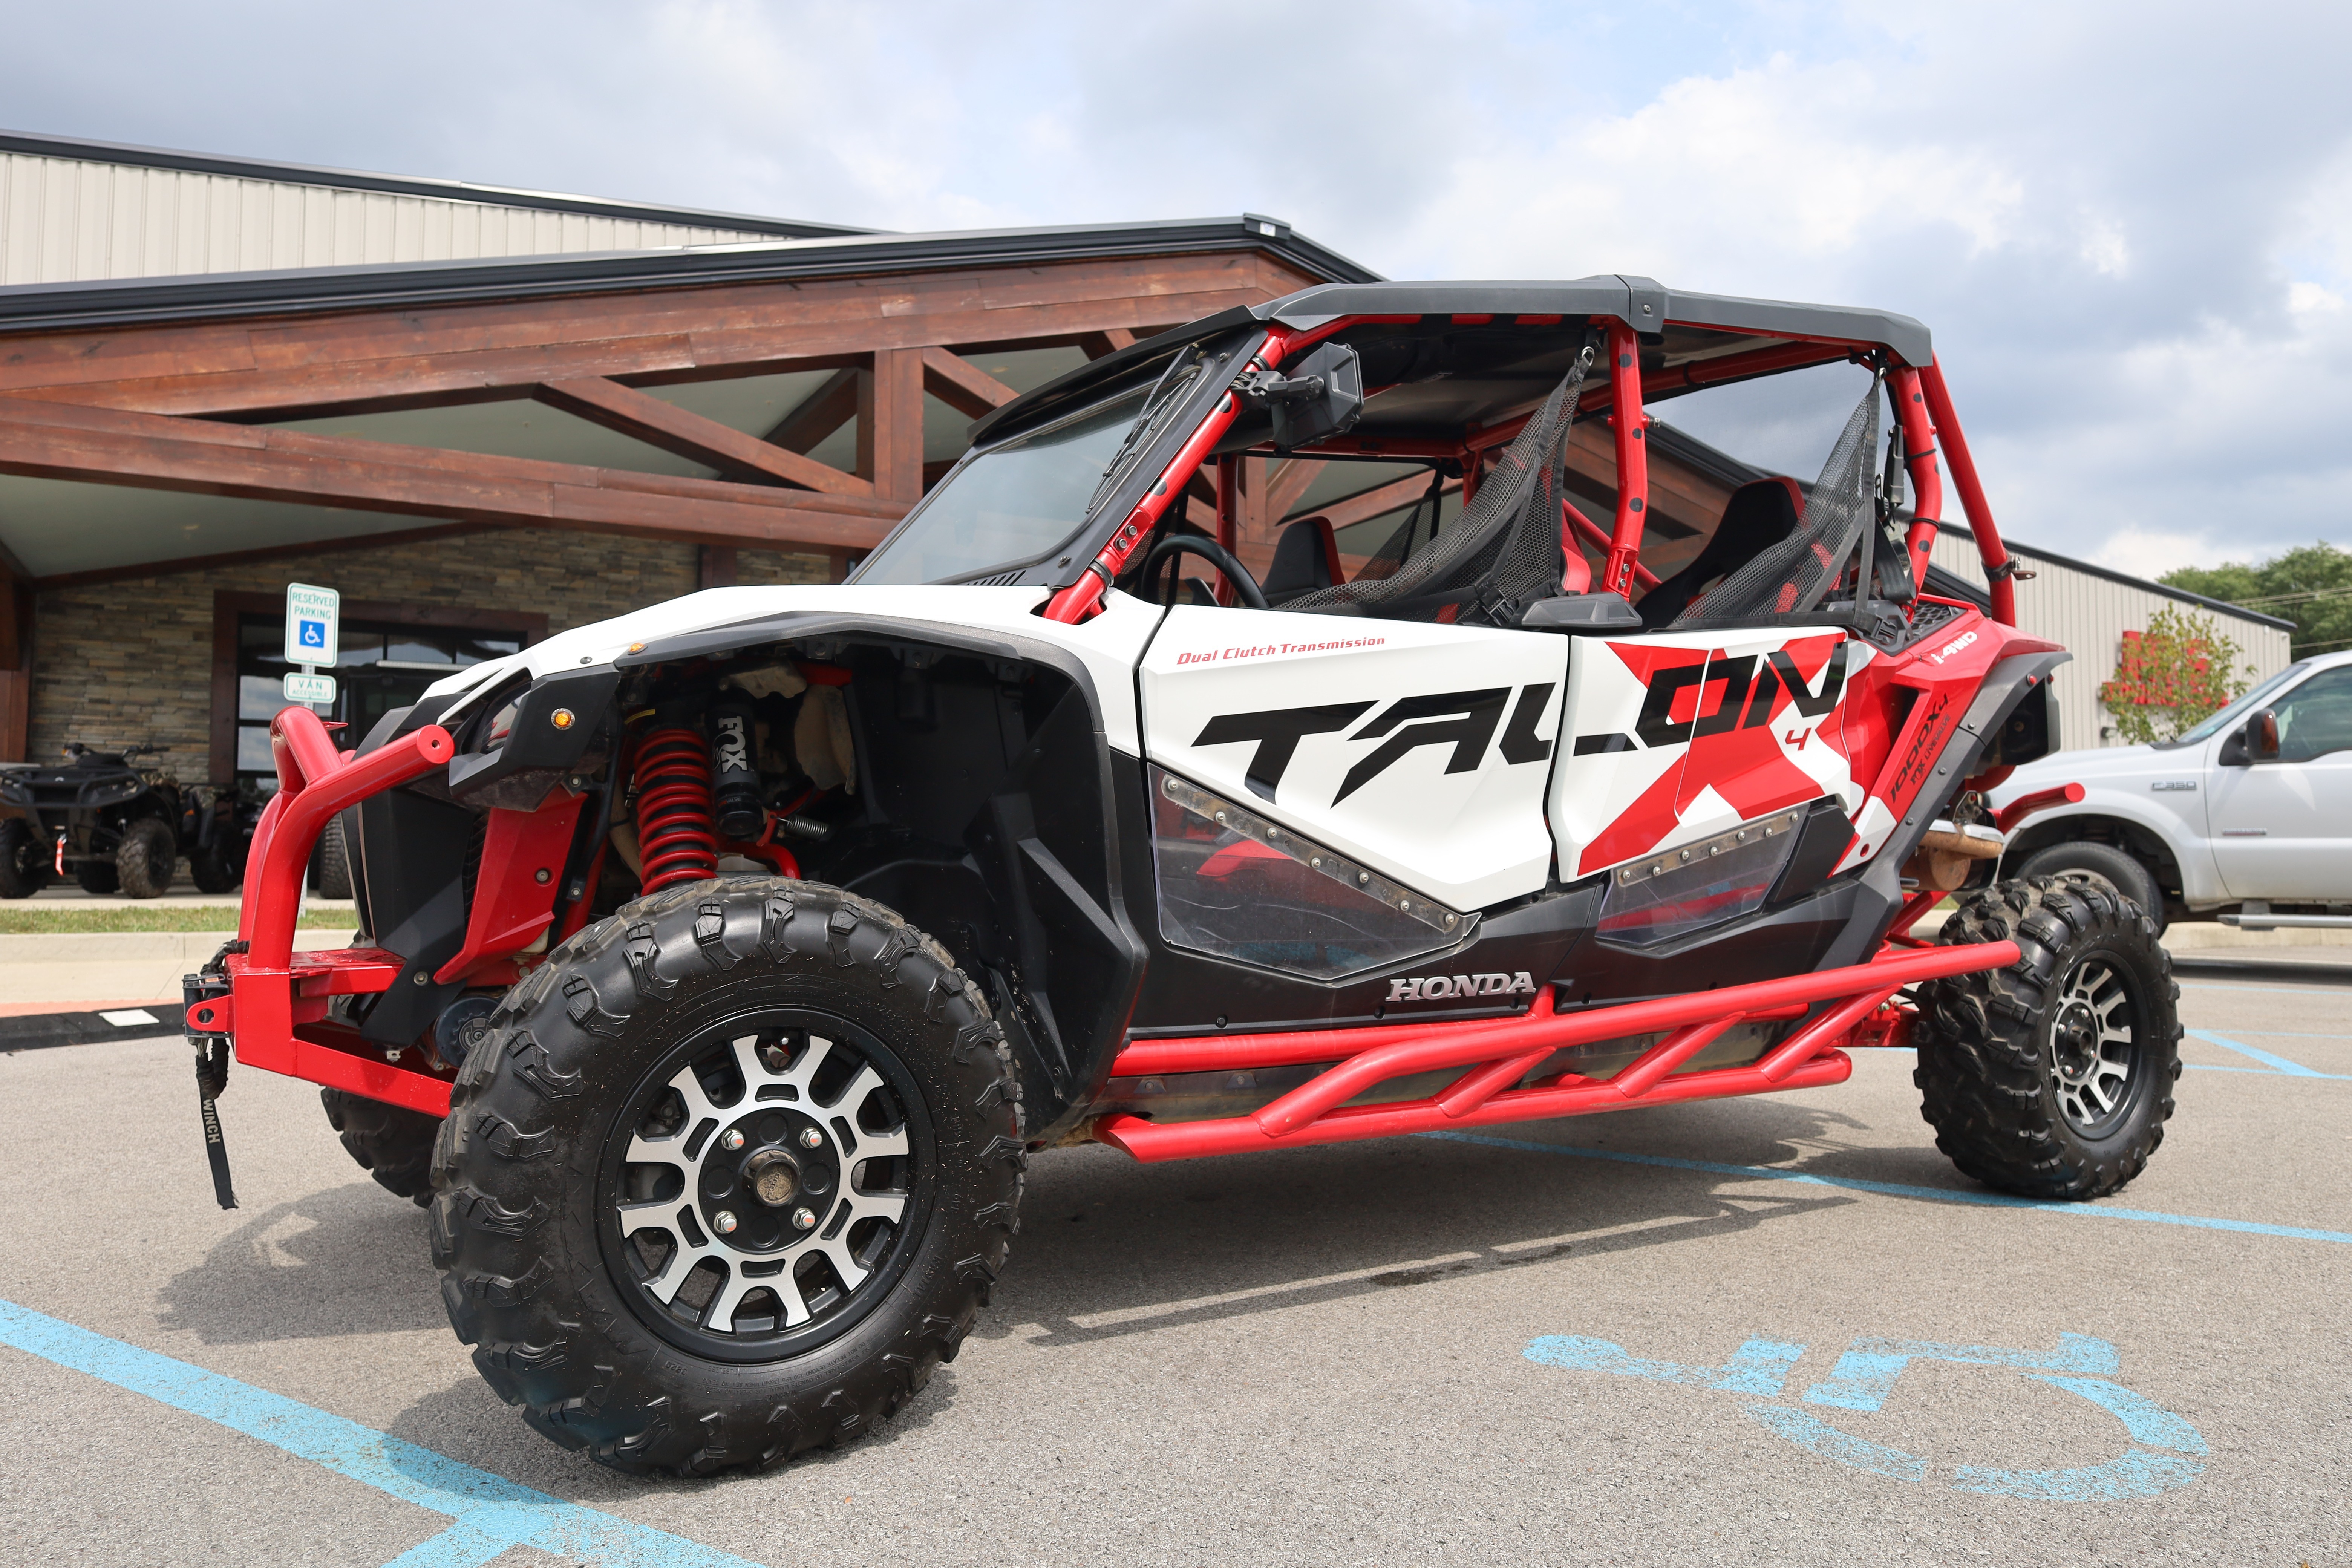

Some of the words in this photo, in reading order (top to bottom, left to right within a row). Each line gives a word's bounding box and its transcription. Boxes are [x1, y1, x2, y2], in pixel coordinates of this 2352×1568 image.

[292, 592, 334, 606] RESERVED
[294, 606, 331, 620] PARKING
[1177, 639, 1219, 665] Dual
[1222, 645, 1276, 660] Clutch
[1280, 637, 1385, 654] Transmission
[1930, 631, 1978, 665] i-4WD
[292, 689, 328, 698] ACCESSIBLE
[299, 680, 322, 690] VAN
[1190, 642, 1848, 809] TALON
[1785, 727, 1811, 751] 4
[714, 716, 747, 773] FOX
[1910, 759, 1926, 785] FOX
[1385, 971, 1537, 1002] HONDA
[203, 1099, 220, 1144] WINCH
